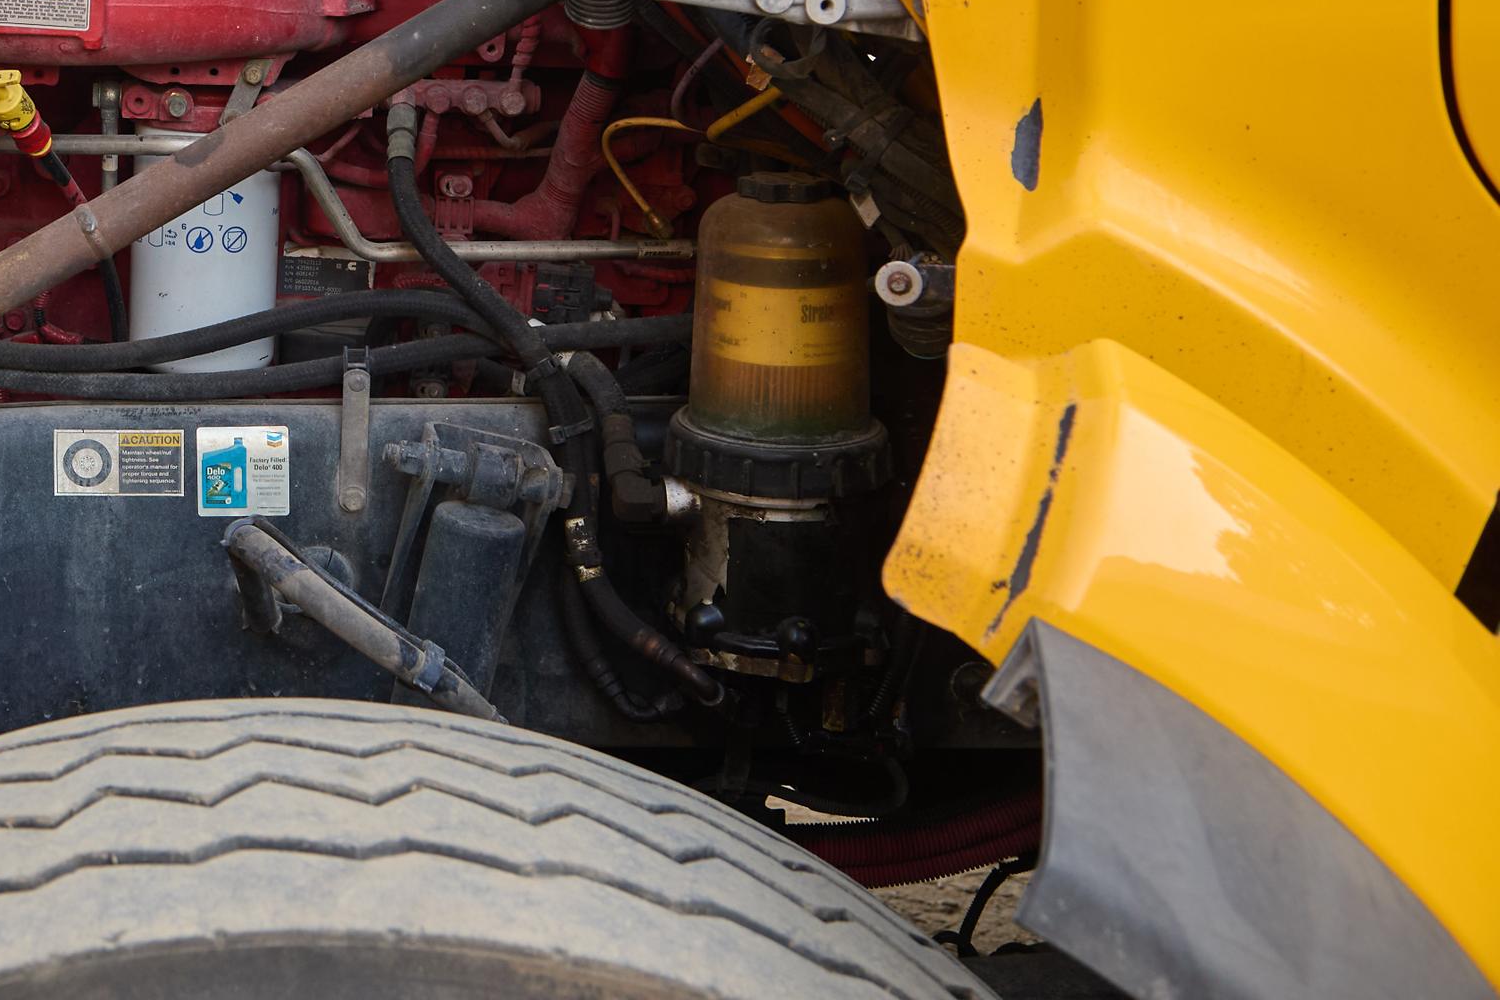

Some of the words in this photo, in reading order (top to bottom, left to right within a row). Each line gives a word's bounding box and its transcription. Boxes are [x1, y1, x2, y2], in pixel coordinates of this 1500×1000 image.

[181, 223, 187, 231] 6
[218, 224, 224, 232] 7
[131, 435, 180, 445] CAUTION
[207, 467, 225, 476] Delo
